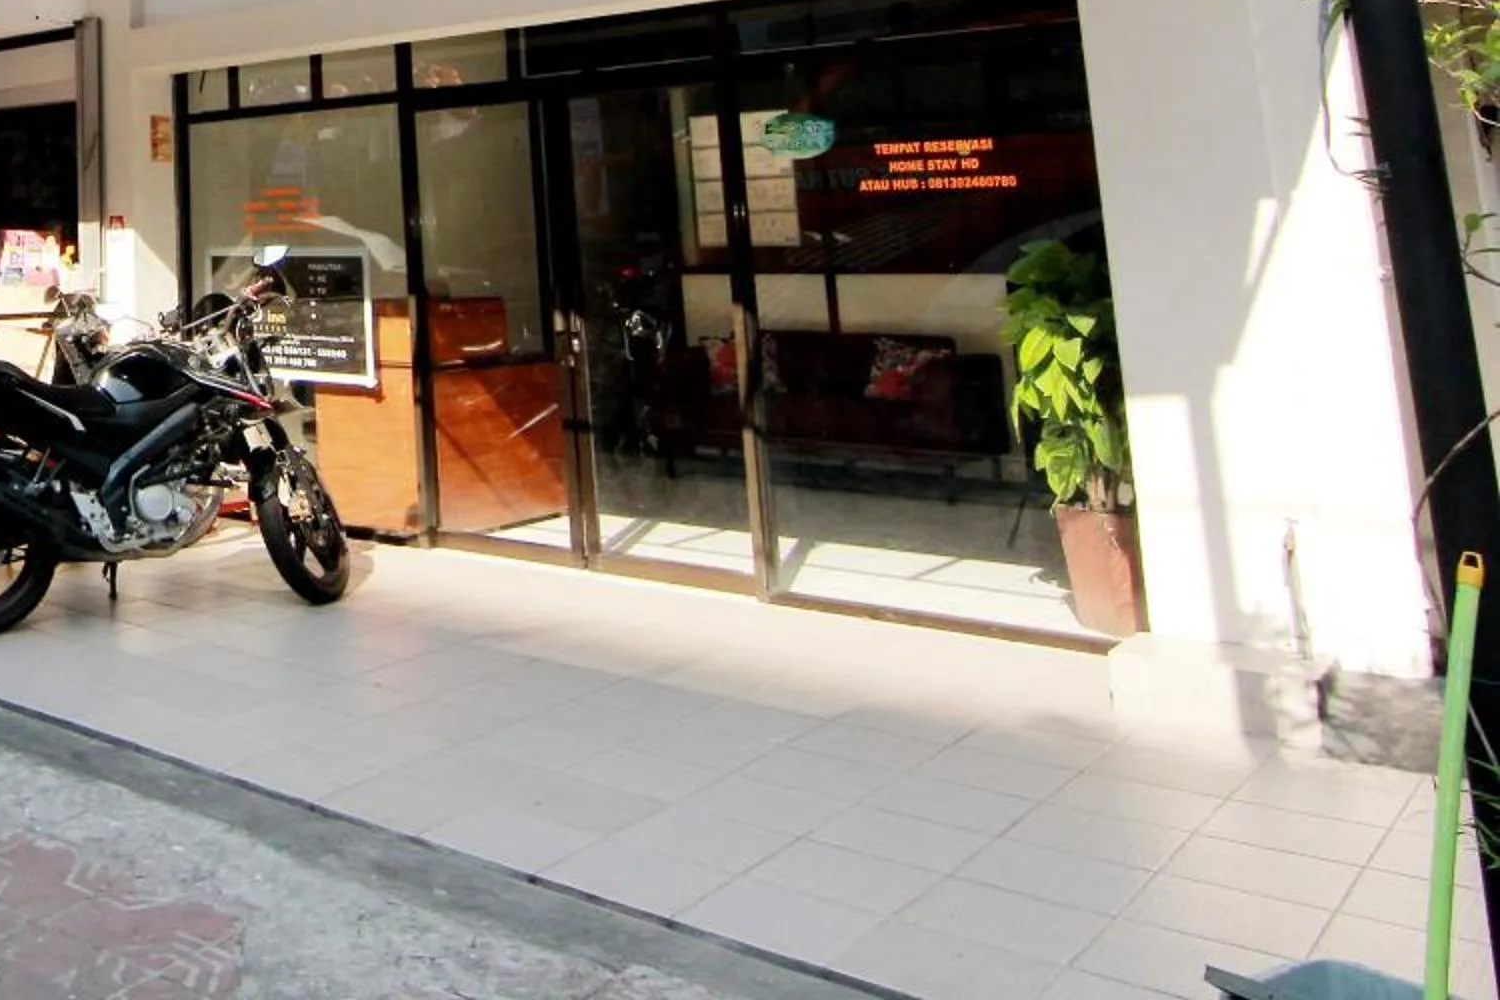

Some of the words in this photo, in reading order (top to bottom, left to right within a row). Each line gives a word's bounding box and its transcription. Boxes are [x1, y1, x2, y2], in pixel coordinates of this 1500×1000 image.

[874, 142, 920, 156] TEMPAT
[923, 138, 994, 154] RESERVASI
[888, 159, 925, 173] HOME
[927, 158, 957, 171] STAY
[961, 157, 980, 169] HD
[859, 179, 889, 192] ATAU
